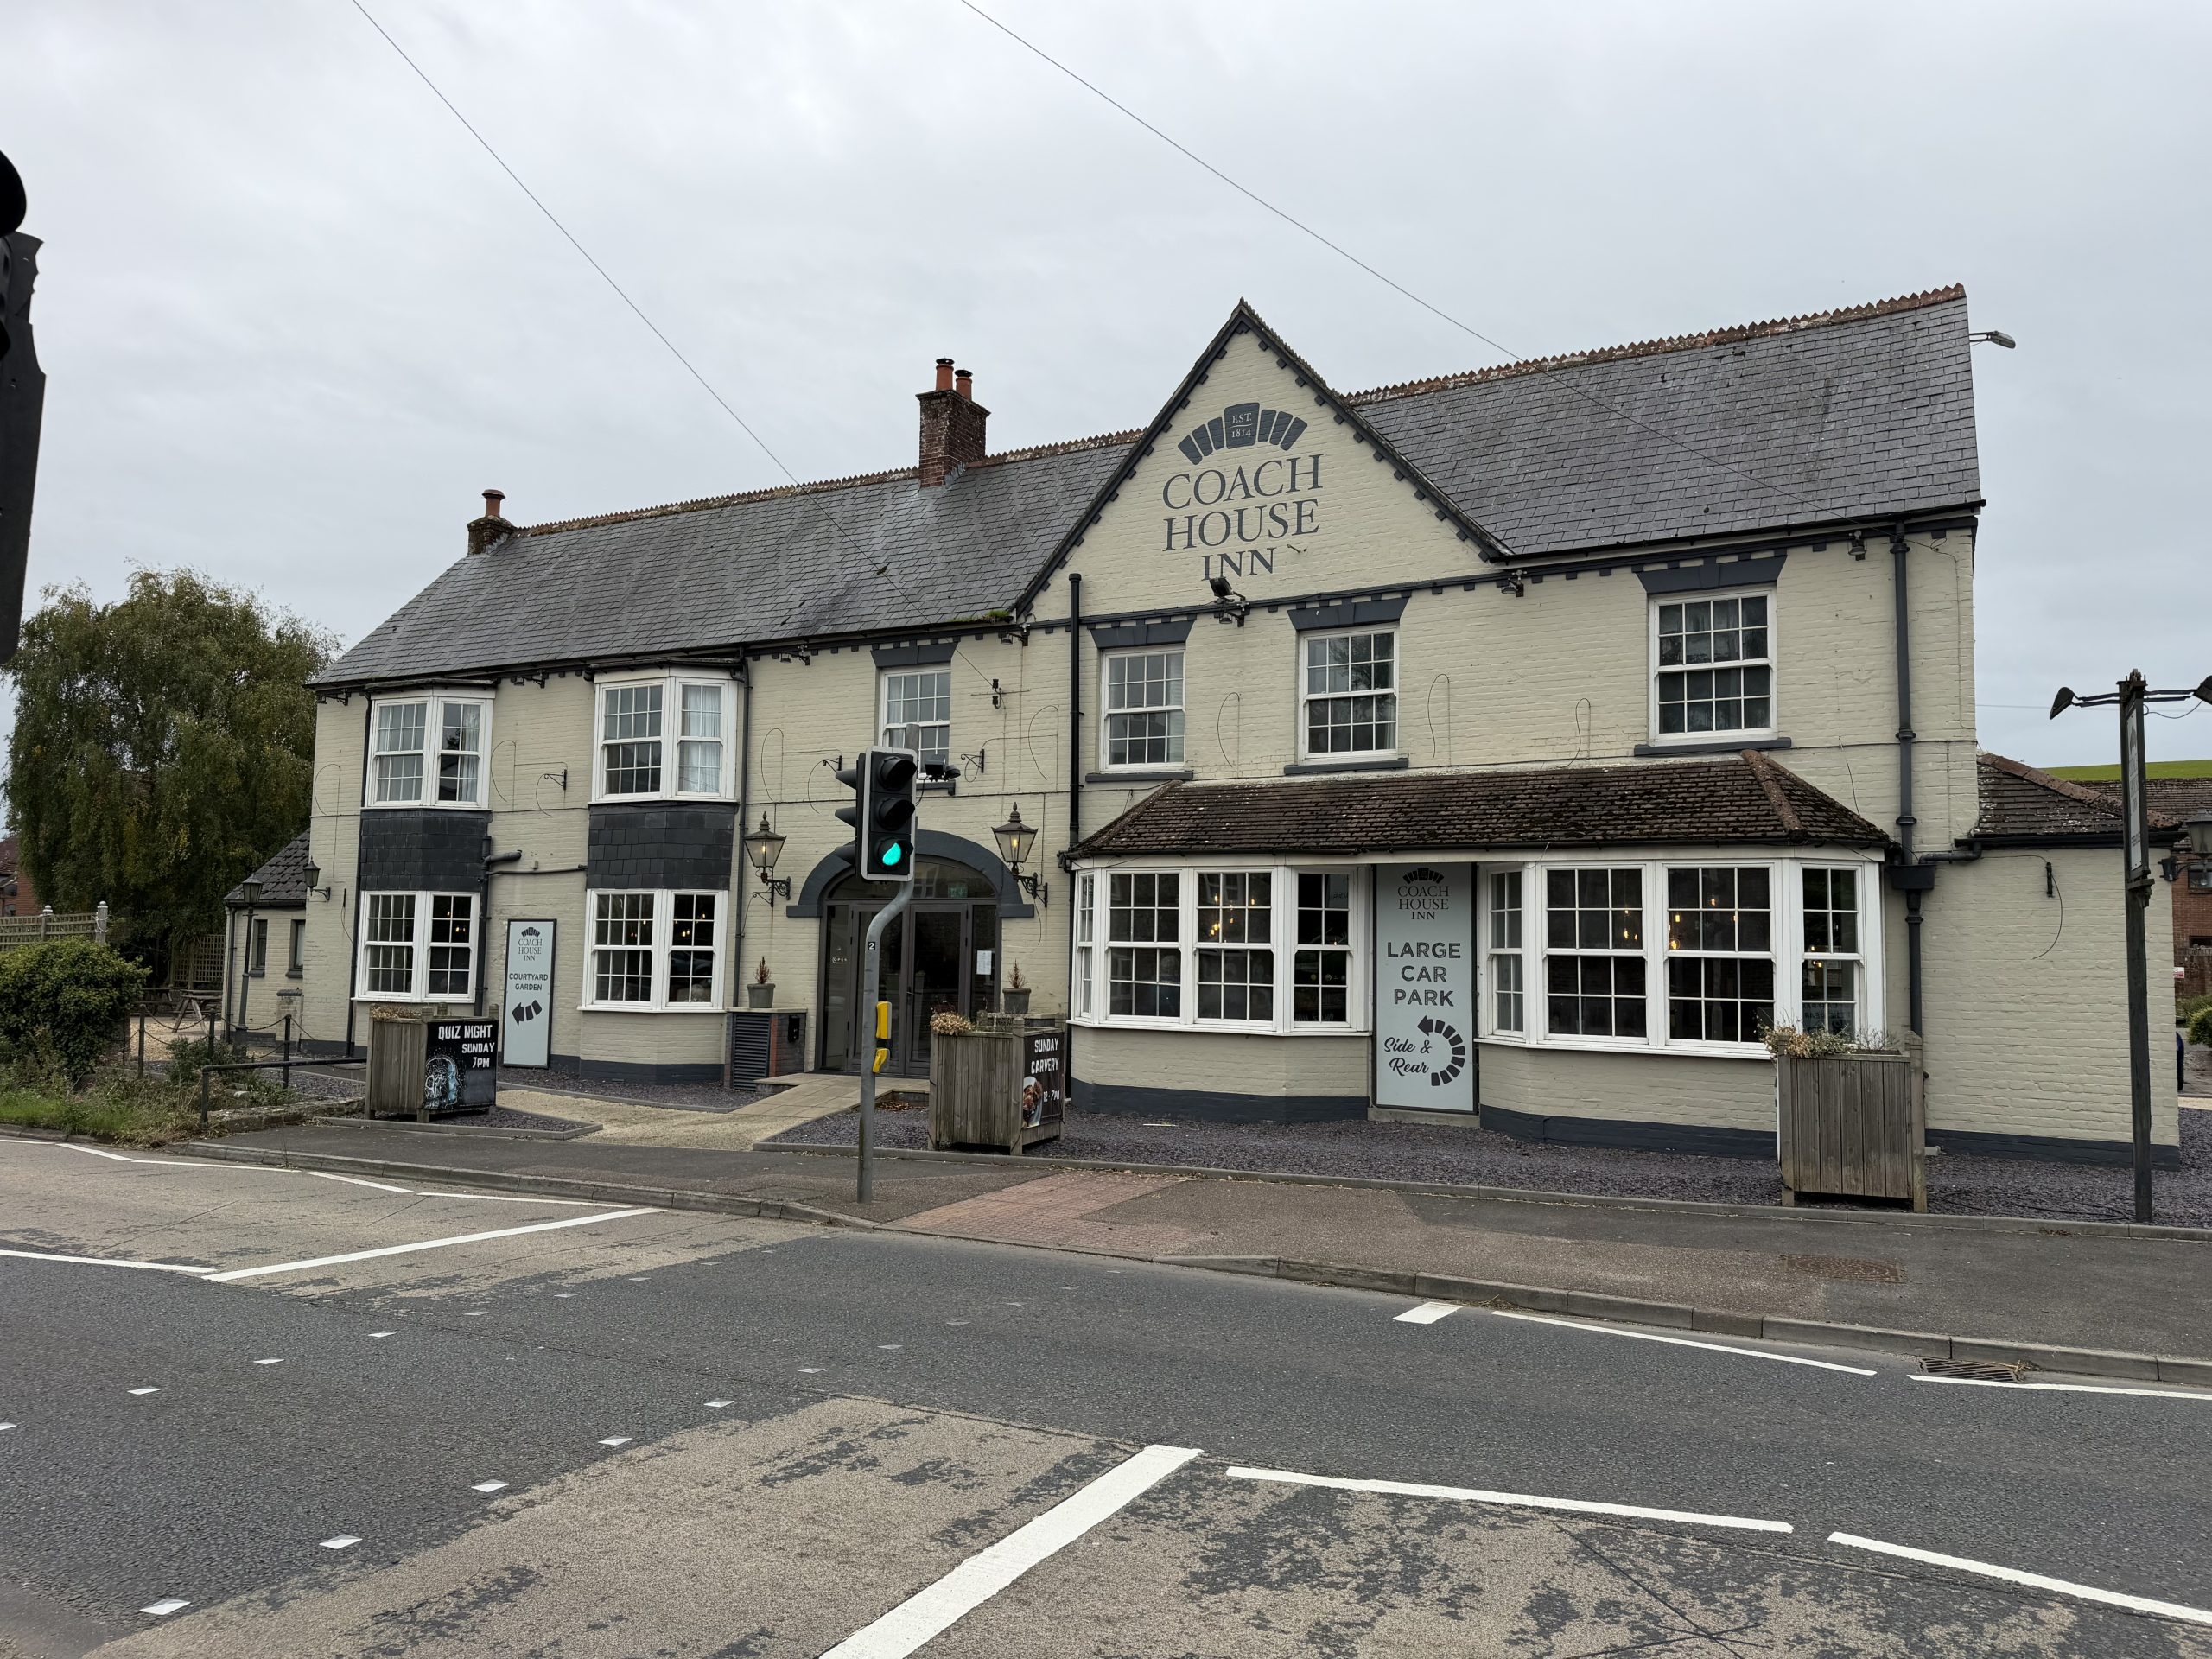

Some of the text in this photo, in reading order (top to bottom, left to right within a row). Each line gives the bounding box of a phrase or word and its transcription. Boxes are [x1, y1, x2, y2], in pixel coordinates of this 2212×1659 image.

[1232, 412, 1252, 424] EST.
[1231, 429, 1251, 438] 1814
[1162, 454, 1325, 509] COACH
[1162, 499, 1320, 551] HOUSE
[1201, 547, 1277, 582] INN
[1397, 885, 1449, 897] COACH
[1398, 898, 1449, 910] HOUSE
[1411, 911, 1435, 920] INN
[518, 946, 542, 955] HOUSE
[868, 942, 874, 950] 2
[1387, 942, 1461, 959] LARGE
[509, 973, 549, 982] COURTYARD
[1401, 965, 1447, 982] CAR
[1394, 988, 1454, 1007] PARK
[438, 1025, 493, 1041] QUIZ NIGHT
[461, 1042, 495, 1054] SUNDAY
[1034, 1038, 1059, 1053] SUNDAY
[1384, 1036, 1433, 1054] Side &
[472, 1057, 490, 1068] 7PM
[1031, 1058, 1059, 1074] CARVERY
[1389, 1057, 1430, 1077] Rear
